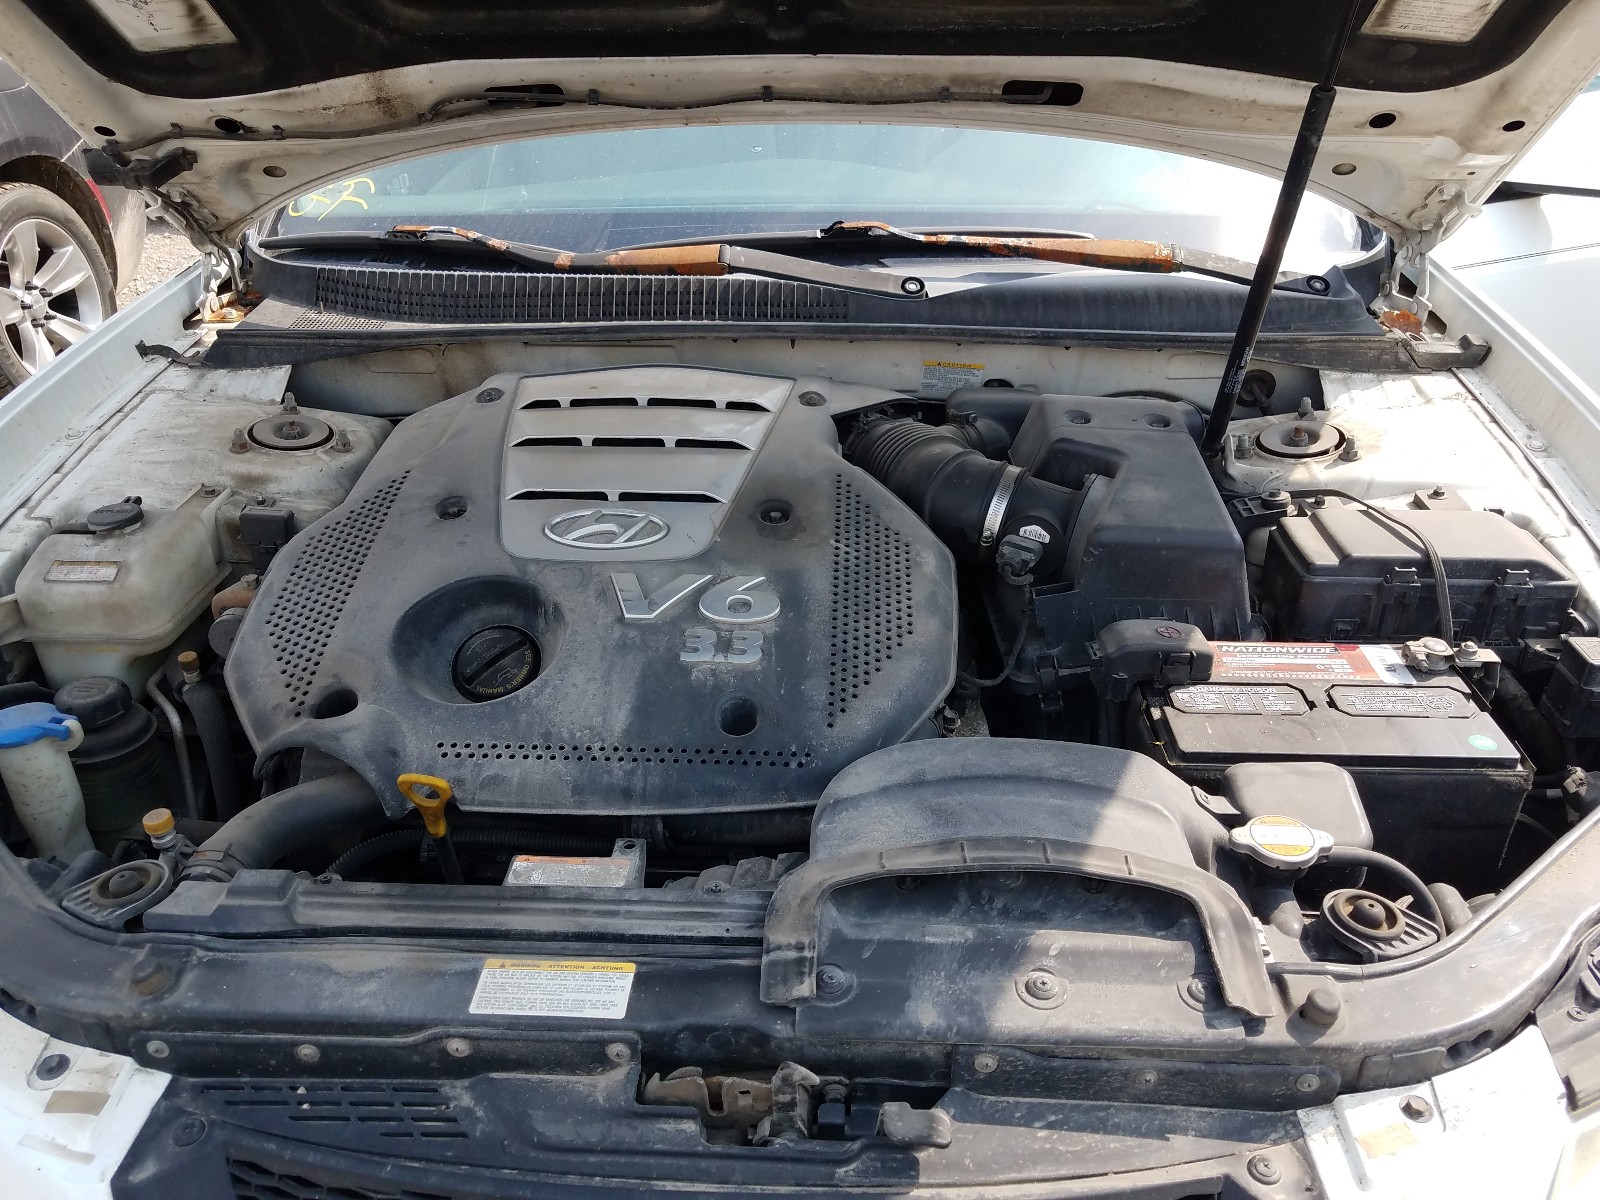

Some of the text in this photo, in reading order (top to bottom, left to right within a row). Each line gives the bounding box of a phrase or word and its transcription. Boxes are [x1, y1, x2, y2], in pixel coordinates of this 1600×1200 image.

[609, 572, 782, 624] V6
[679, 627, 765, 664] 3.3
[1221, 645, 1338, 654] NATIONWIDE
[524, 649, 532, 662] SEE
[475, 685, 504, 694] MANUAL
